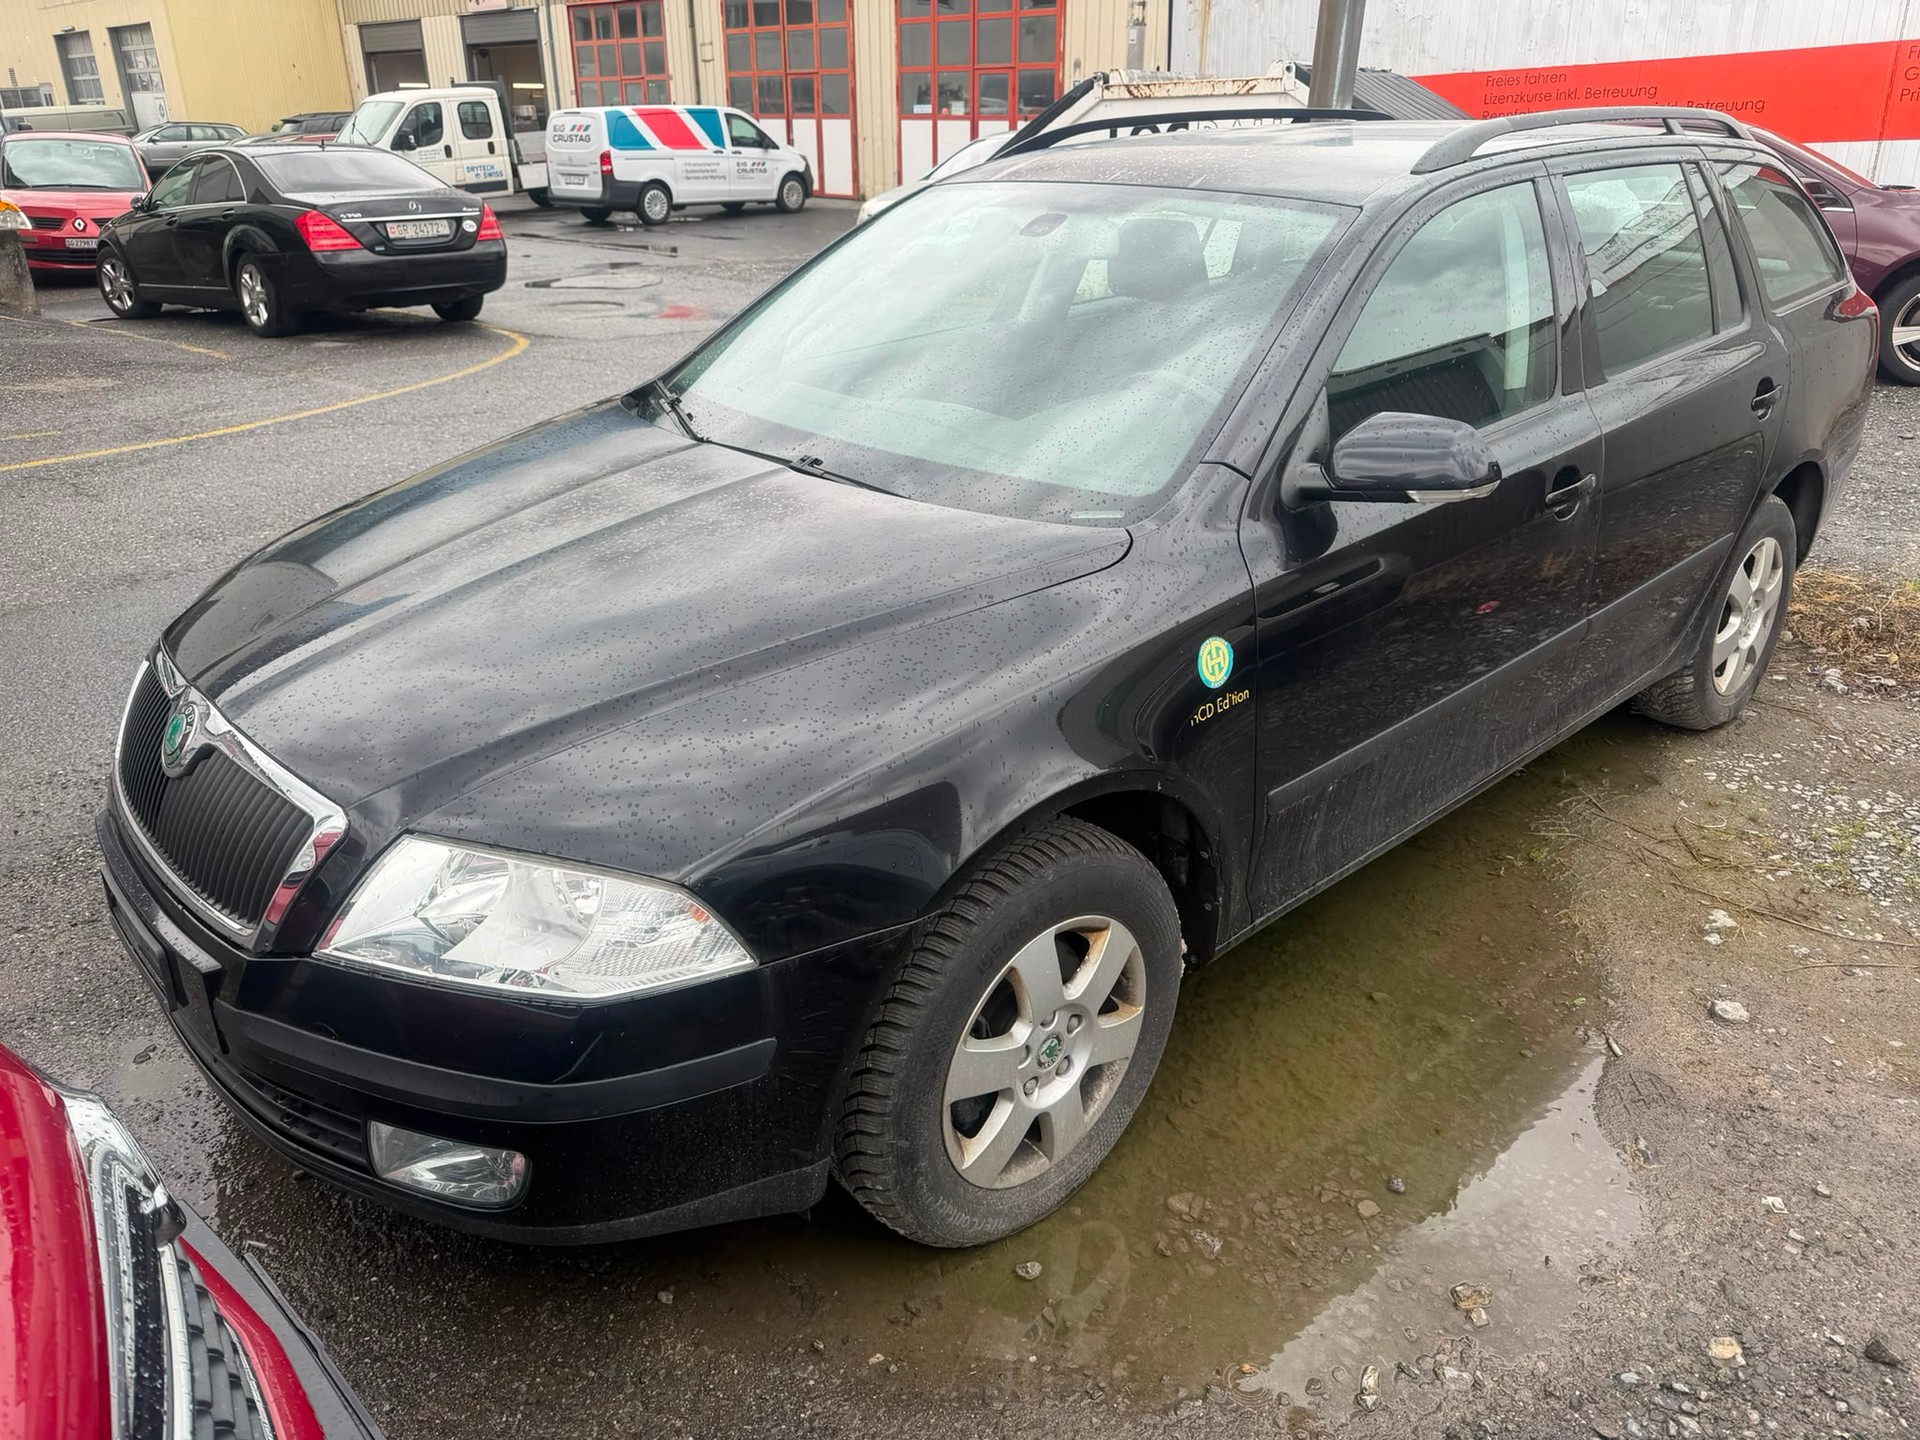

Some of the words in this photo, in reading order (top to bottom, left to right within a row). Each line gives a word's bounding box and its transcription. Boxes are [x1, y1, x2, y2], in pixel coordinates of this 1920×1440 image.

[1485, 74, 1521, 88] Freies
[1523, 72, 1567, 86] fahren
[1483, 90, 1553, 106] Lizenzkurse
[1555, 88, 1580, 101] inkl.
[1585, 85, 1658, 99] Betreuung
[552, 134, 592, 143] CRUSTAG
